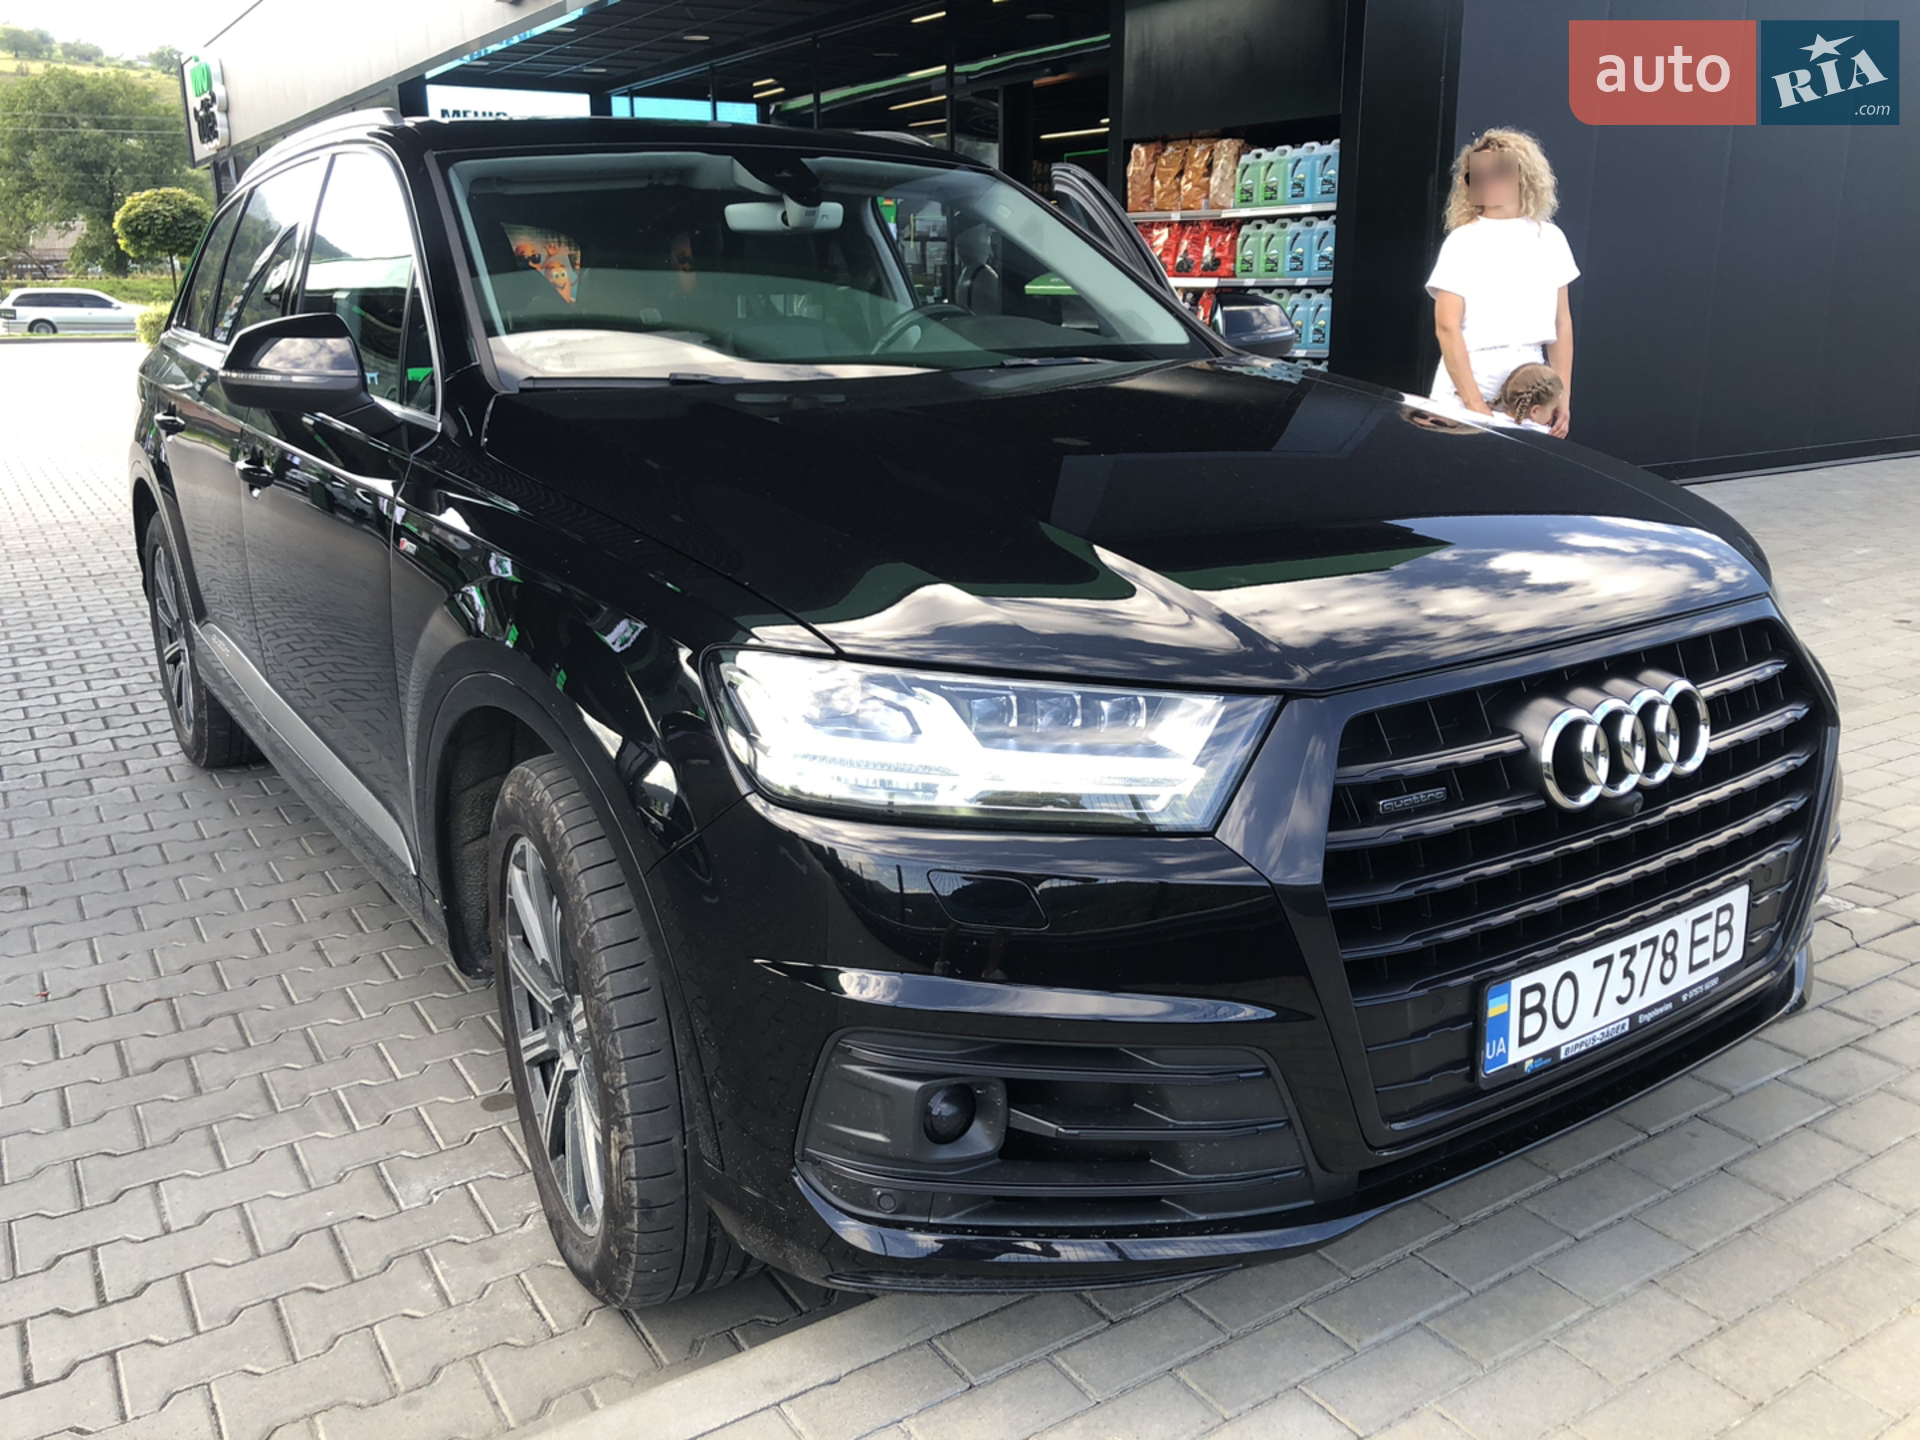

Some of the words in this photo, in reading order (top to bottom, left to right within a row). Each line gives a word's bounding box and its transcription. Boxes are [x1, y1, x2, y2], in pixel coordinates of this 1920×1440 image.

[1383, 791, 1444, 811] quattro
[1518, 970, 1579, 1048] BO
[1592, 928, 1679, 1018] 7378
[1688, 902, 1734, 975] EB
[1486, 1039, 1506, 1060] UA
